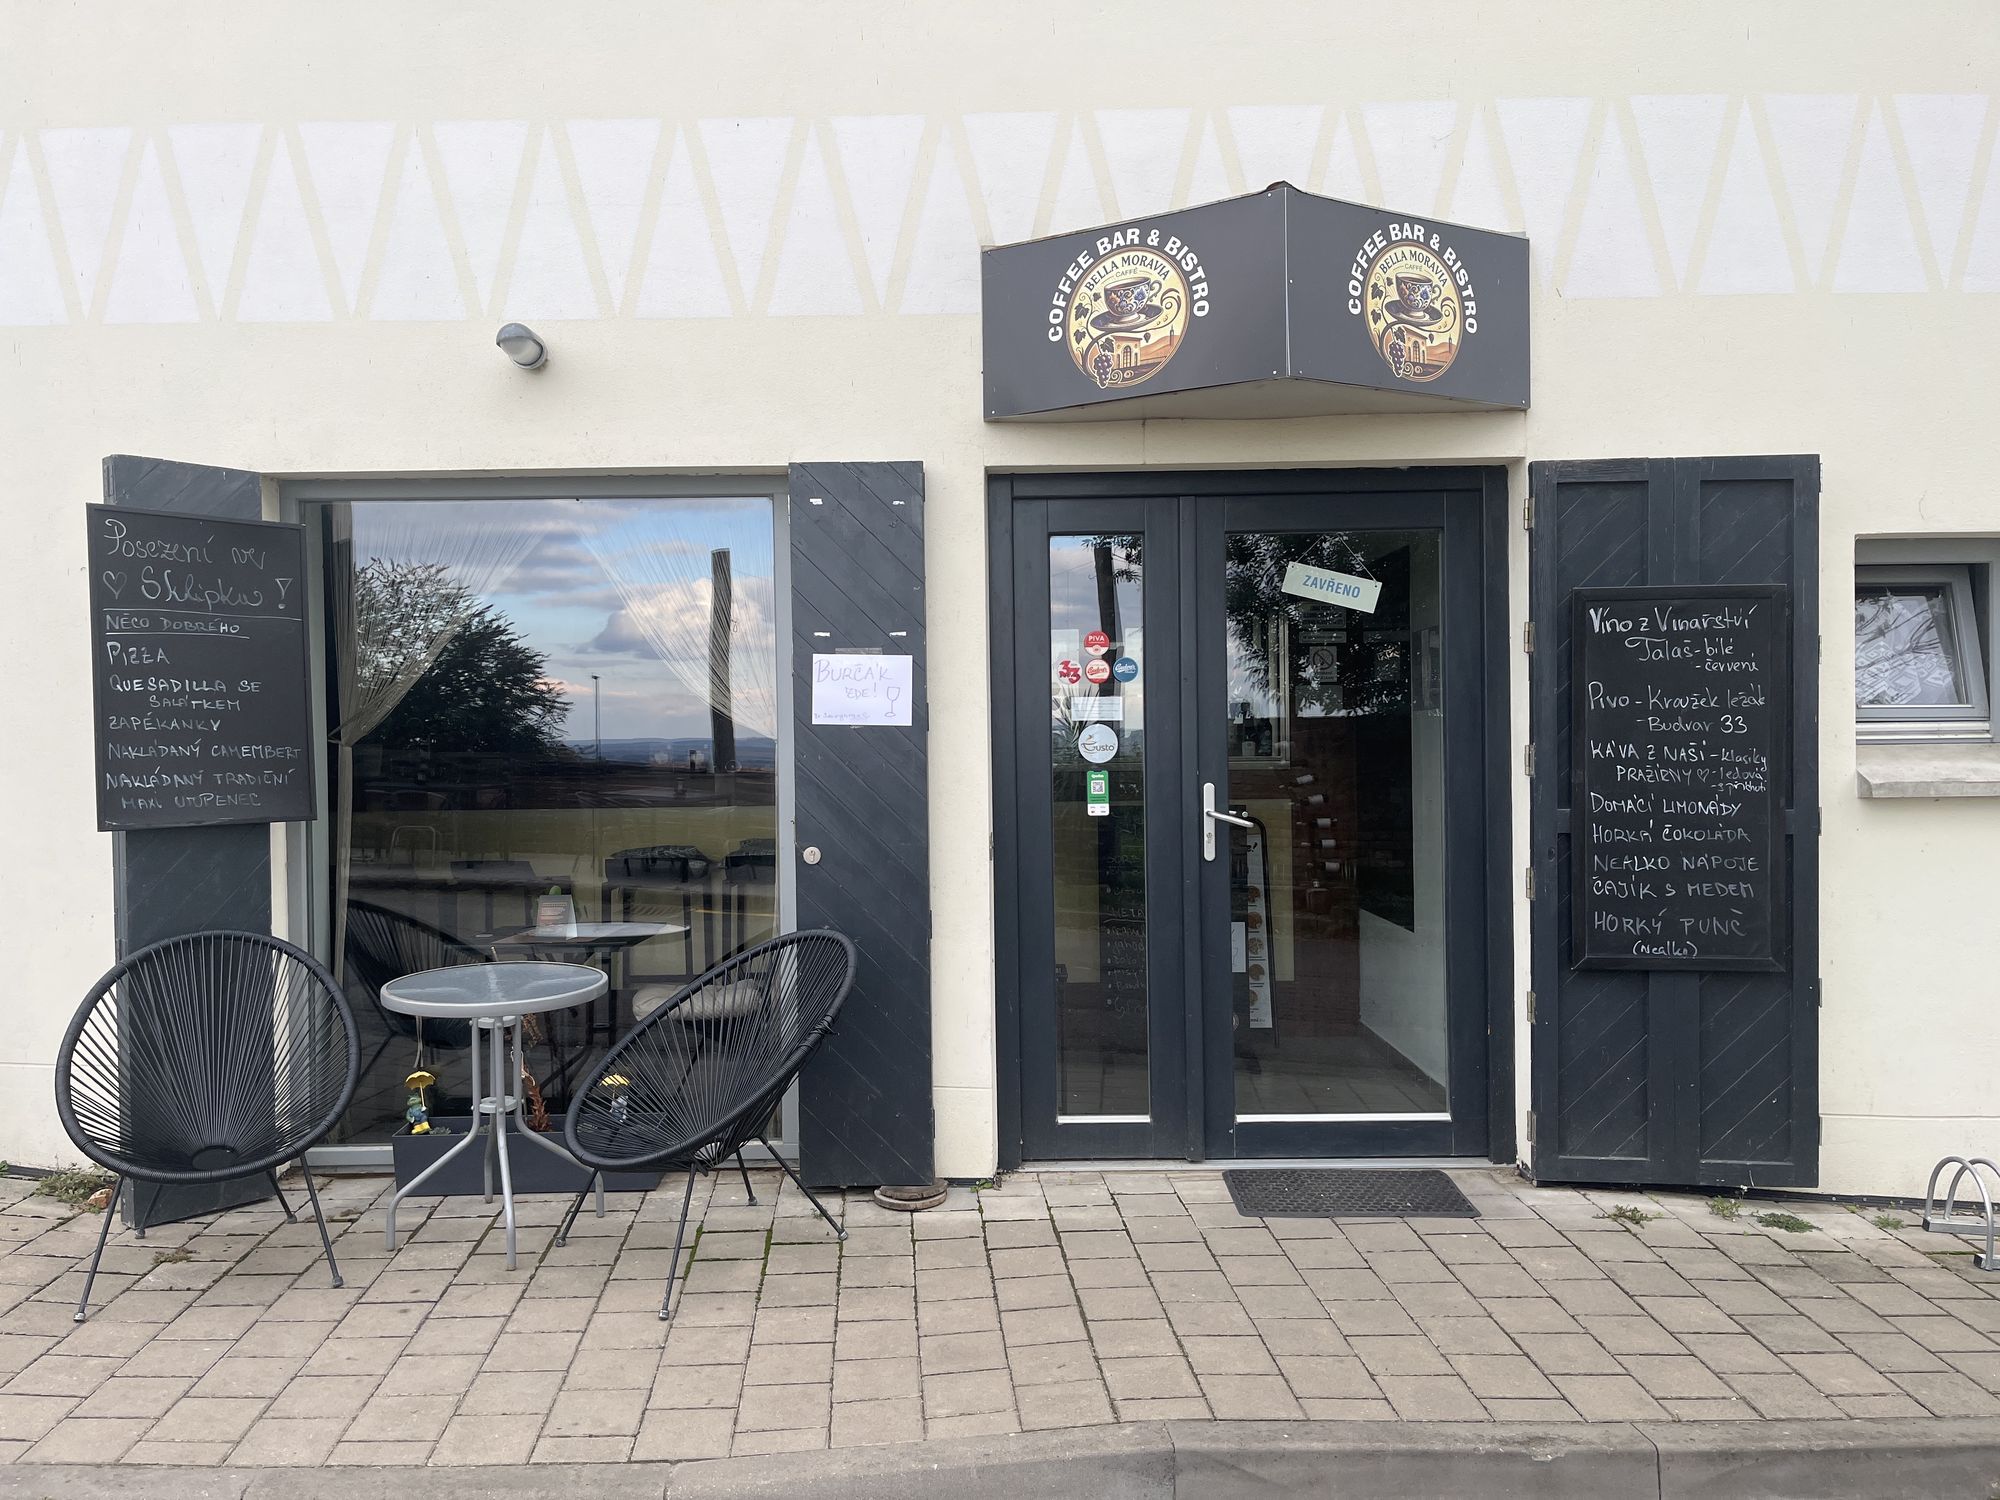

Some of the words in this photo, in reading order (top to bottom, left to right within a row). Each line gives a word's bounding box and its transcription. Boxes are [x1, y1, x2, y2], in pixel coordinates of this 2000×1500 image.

[1085, 261, 1119, 292] BELLA
[1121, 254, 1171, 281] MORAVIA
[1348, 229, 1388, 315] COFFEE
[1389, 222, 1425, 243] BAR
[1430, 233, 1440, 252] &
[1443, 247, 1478, 334] BISTRO
[1379, 250, 1408, 275] BELLA
[1409, 250, 1448, 287] MORAVIA
[1048, 250, 1094, 342] COFFEE
[1096, 228, 1140, 256] BAR
[1147, 229, 1160, 246] &
[1164, 236, 1210, 317] BISTRO
[1303, 575, 1361, 599] ZAVŘENO
[1589, 607, 1633, 635] Víno
[110, 674, 227, 692] QUESADILLA
[238, 680, 262, 692] SE
[1720, 714, 1748, 734] 33
[1594, 854, 1670, 872] NEALKO
[1687, 882, 1755, 899] MEDEM
